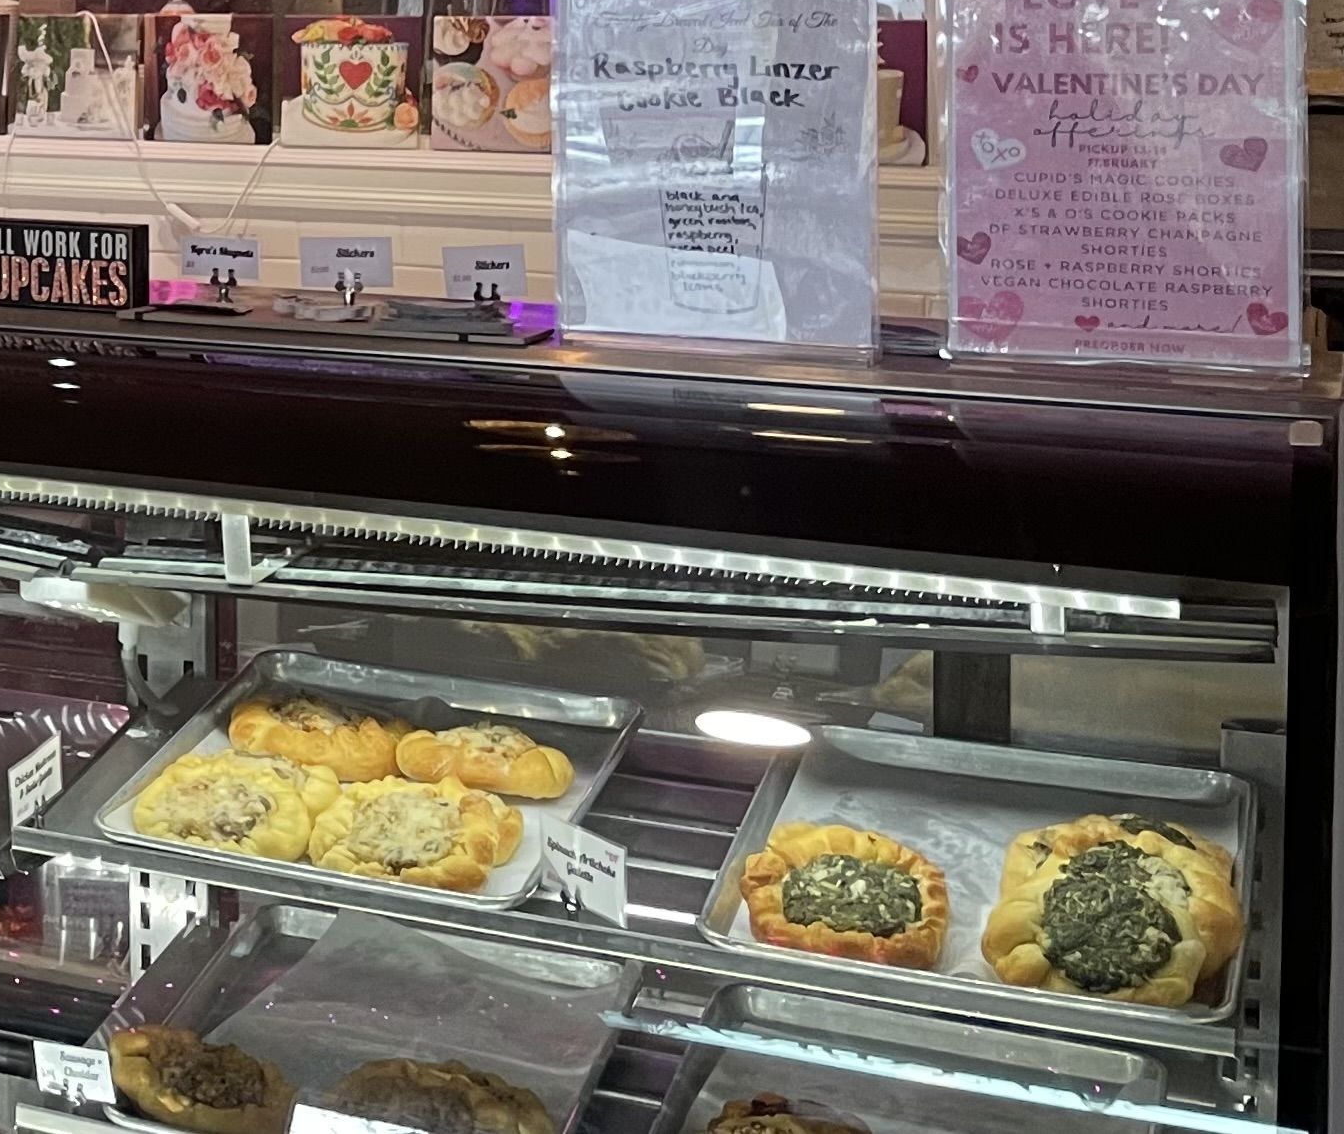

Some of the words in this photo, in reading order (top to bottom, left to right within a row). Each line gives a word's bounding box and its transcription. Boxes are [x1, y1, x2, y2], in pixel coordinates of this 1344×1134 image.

[991, 21, 1031, 54] IS
[1048, 21, 1171, 55] HERE!
[592, 52, 739, 90] Raspberry
[749, 55, 840, 81] Linzer
[991, 71, 1189, 97] VALENTINE'S
[1197, 73, 1265, 96] DAY
[616, 88, 702, 111] Cookie
[716, 87, 806, 108] Black
[1013, 171, 1083, 185] CUPID'S
[1089, 174, 1147, 186] MAGIC
[1154, 175, 1236, 188] COOKIES
[994, 188, 1063, 202] DELUXE
[1070, 191, 1133, 204] EDIBLE
[1140, 192, 1185, 205] ROSE
[1099, 208, 1168, 223] COOKIE
[1176, 211, 1237, 224] PACKS
[1018, 224, 1140, 239] STRAWBERRY
[1147, 228, 1263, 243] CHAMPAGNE
[23, 229, 82, 258] WORK
[89, 232, 128, 261] FOR
[1080, 243, 1168, 258] SHORTIES
[1060, 261, 1164, 276] RASPBERRY
[980, 275, 1042, 288] VEGAN
[1048, 278, 1158, 294] CHOCOLATE
[1165, 282, 1273, 298] RASPBERRY
[1081, 296, 1169, 312] SHORTIES
